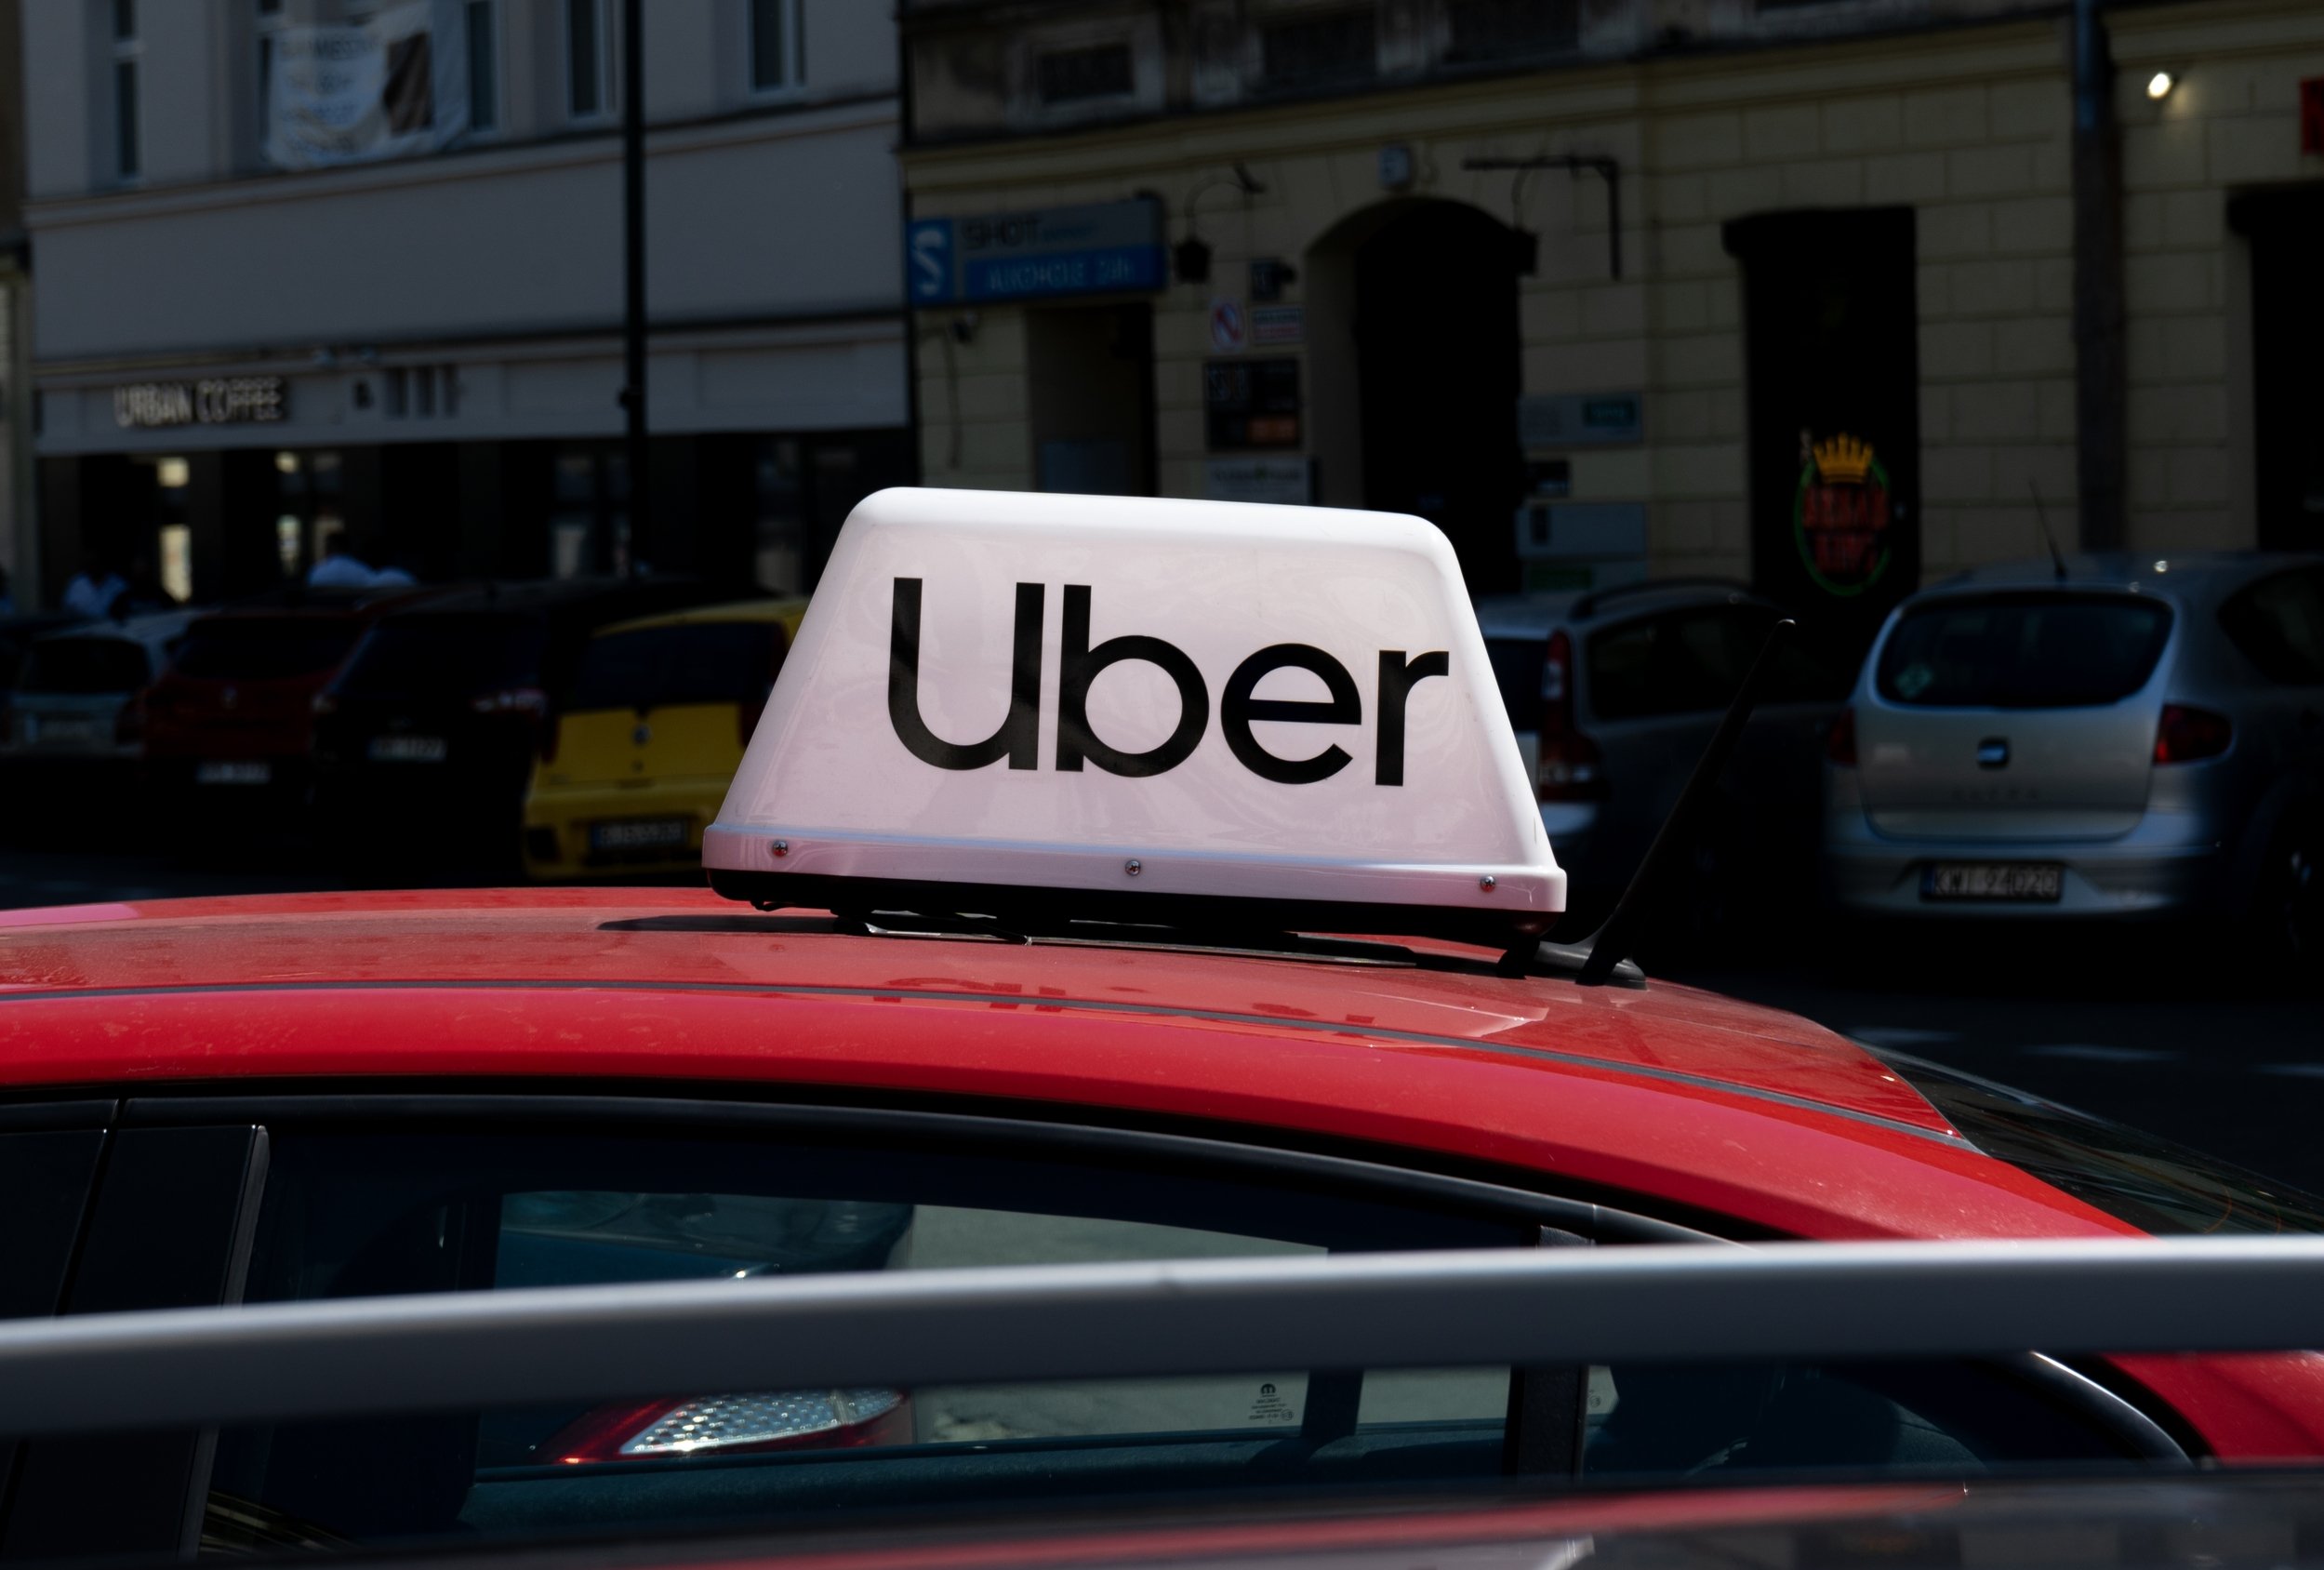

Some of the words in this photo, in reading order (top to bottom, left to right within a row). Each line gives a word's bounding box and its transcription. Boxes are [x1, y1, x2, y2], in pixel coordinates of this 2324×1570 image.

[963, 217, 1040, 248] SHOT
[114, 382, 193, 427] URBAN
[195, 377, 283, 423] COFFEE
[888, 577, 1449, 787] Uber
